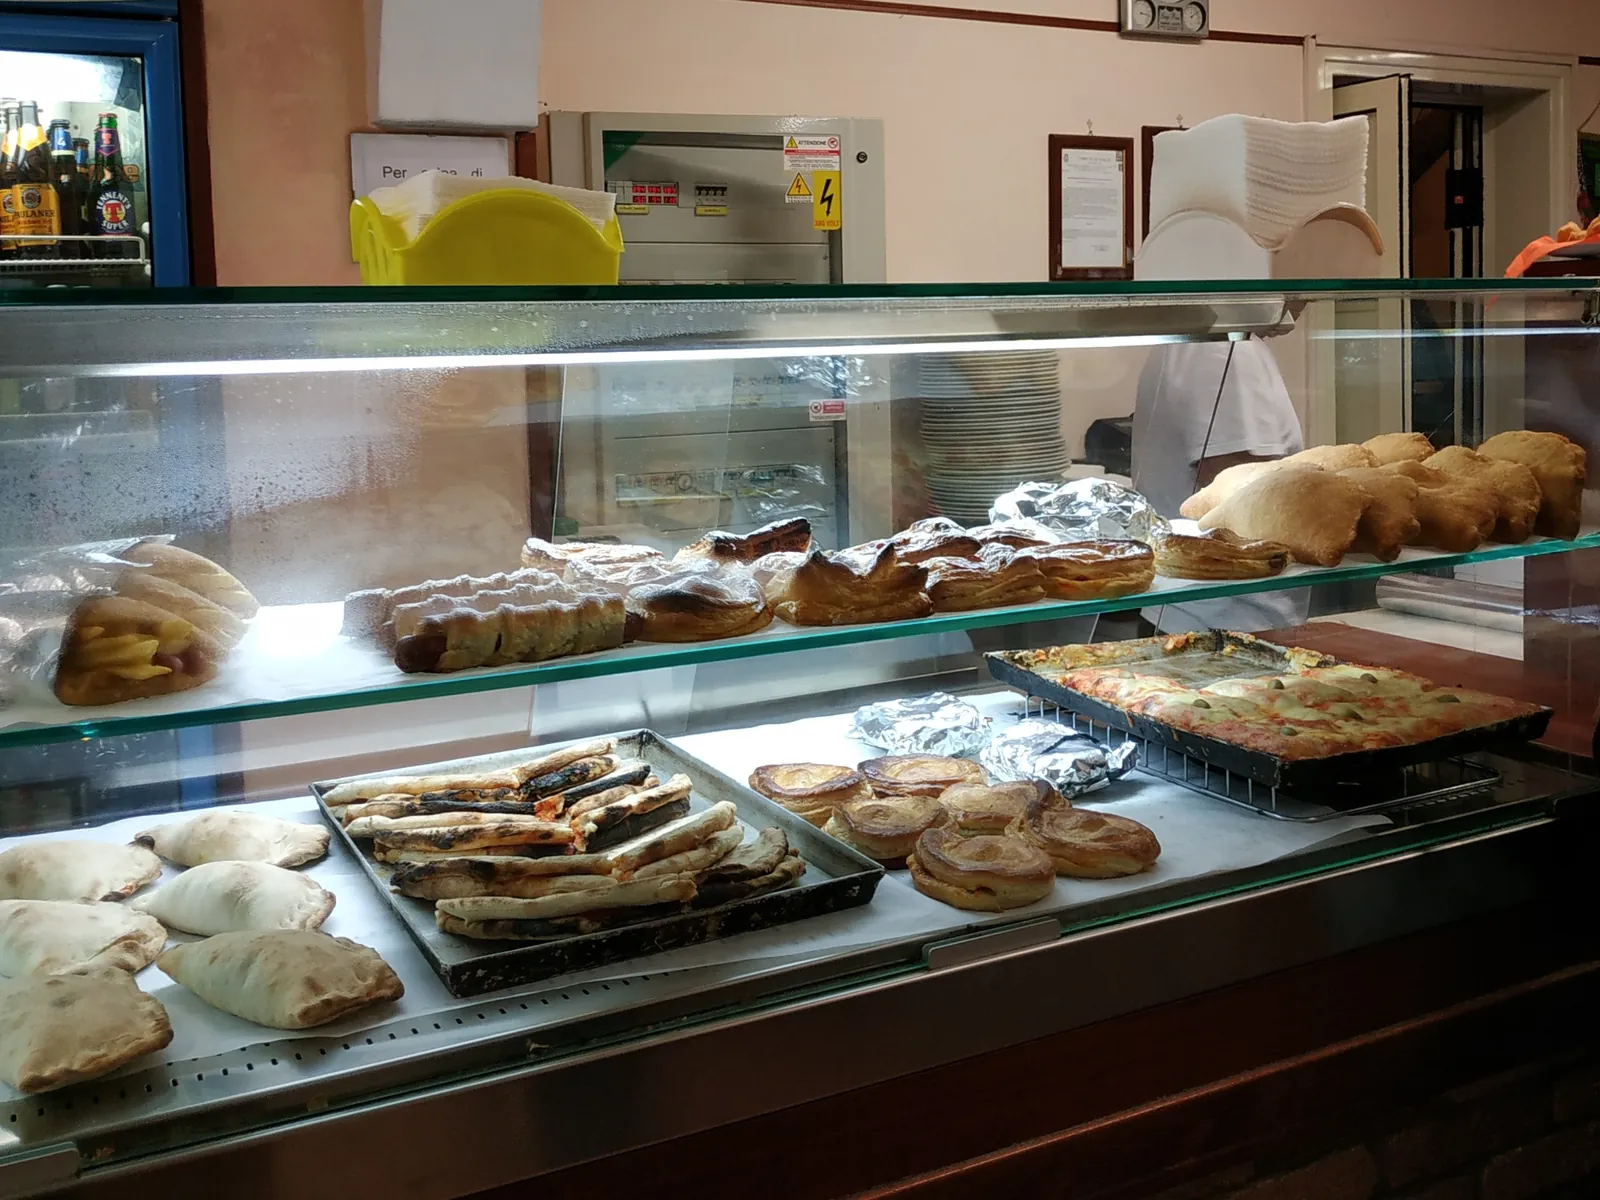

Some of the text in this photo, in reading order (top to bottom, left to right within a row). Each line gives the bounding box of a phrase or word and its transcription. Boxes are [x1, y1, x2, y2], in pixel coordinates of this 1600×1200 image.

[382, 166, 483, 179] Per di
[14, 209, 55, 217] AULANER
[101, 219, 129, 230] SUPER
